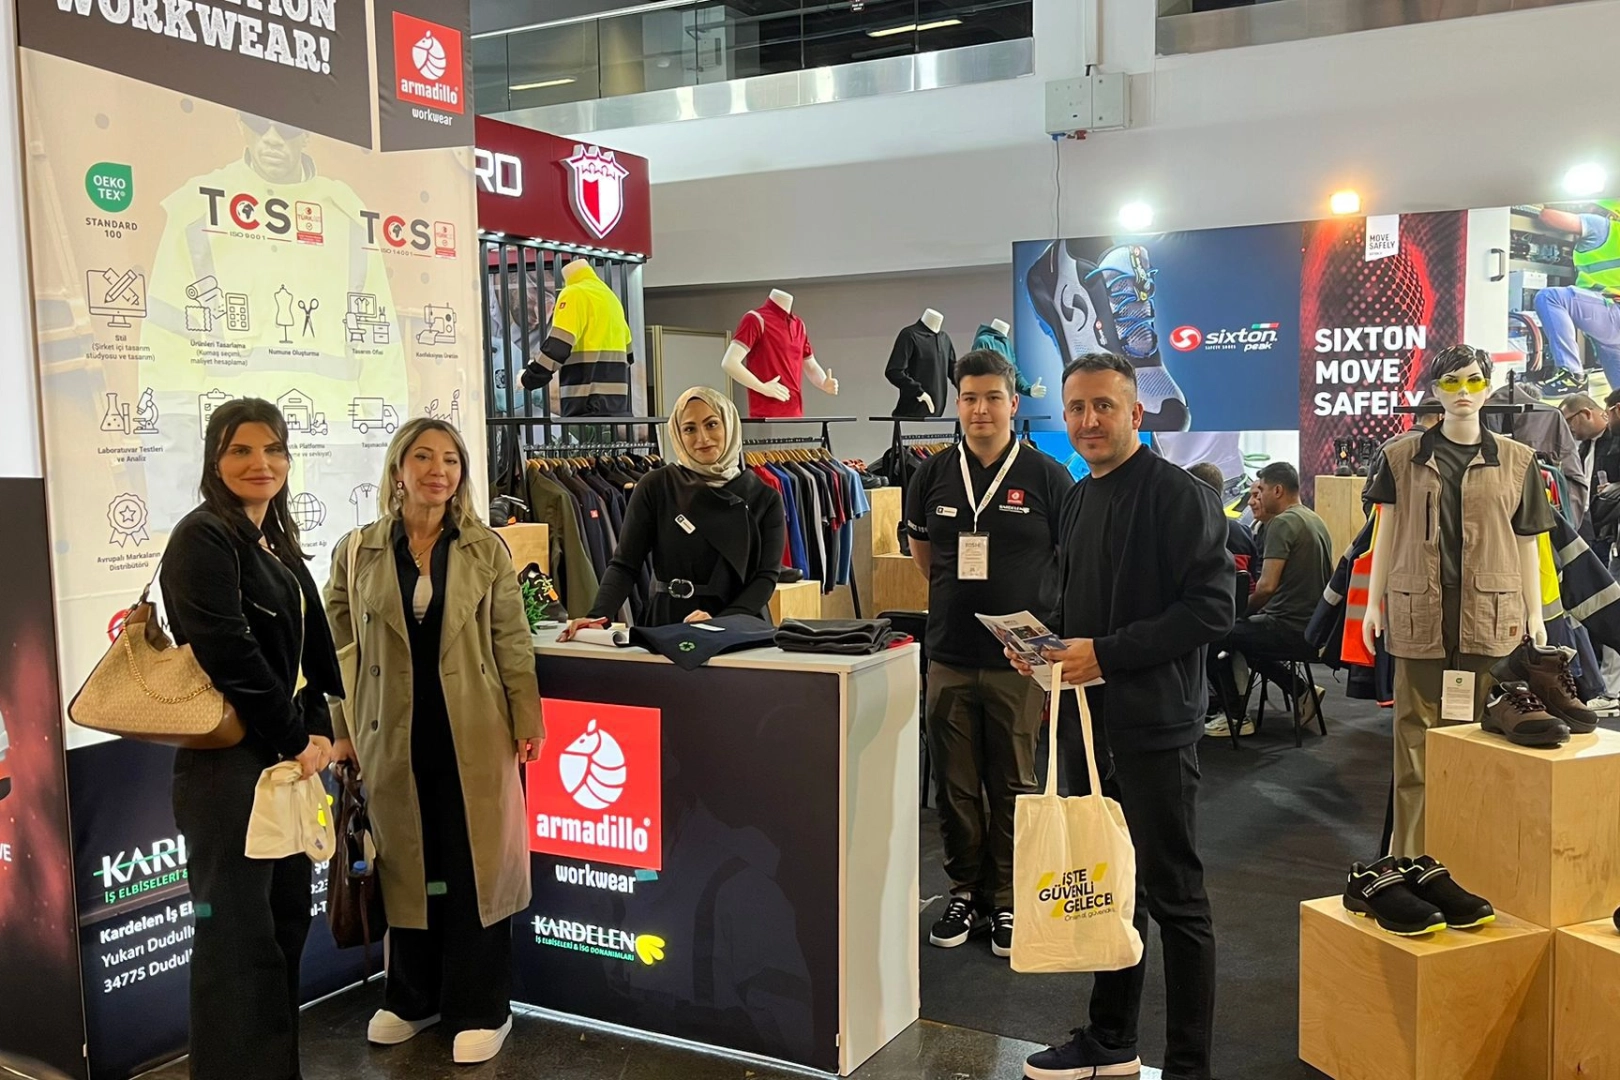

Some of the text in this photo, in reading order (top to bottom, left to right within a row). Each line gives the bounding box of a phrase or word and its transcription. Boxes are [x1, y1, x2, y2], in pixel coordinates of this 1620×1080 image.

[412, 108, 453, 126] workwear
[93, 174, 126, 189] OEKO
[199, 186, 291, 235] TCS
[85, 217, 138, 231] STANDARD
[104, 230, 122, 239] 100
[359, 209, 431, 251] TCS
[1369, 233, 1389, 242] MOVE
[1369, 240, 1396, 250] SAFELY
[1243, 342, 1273, 352] peak
[1313, 325, 1427, 353] SIXTON
[1315, 358, 1400, 384] MOVE
[555, 864, 636, 894] workwear
[100, 913, 164, 944] Kardelen
[533, 914, 635, 953] KARDELEN
[101, 944, 145, 968] Yukarı
[103, 966, 146, 993] 34775
